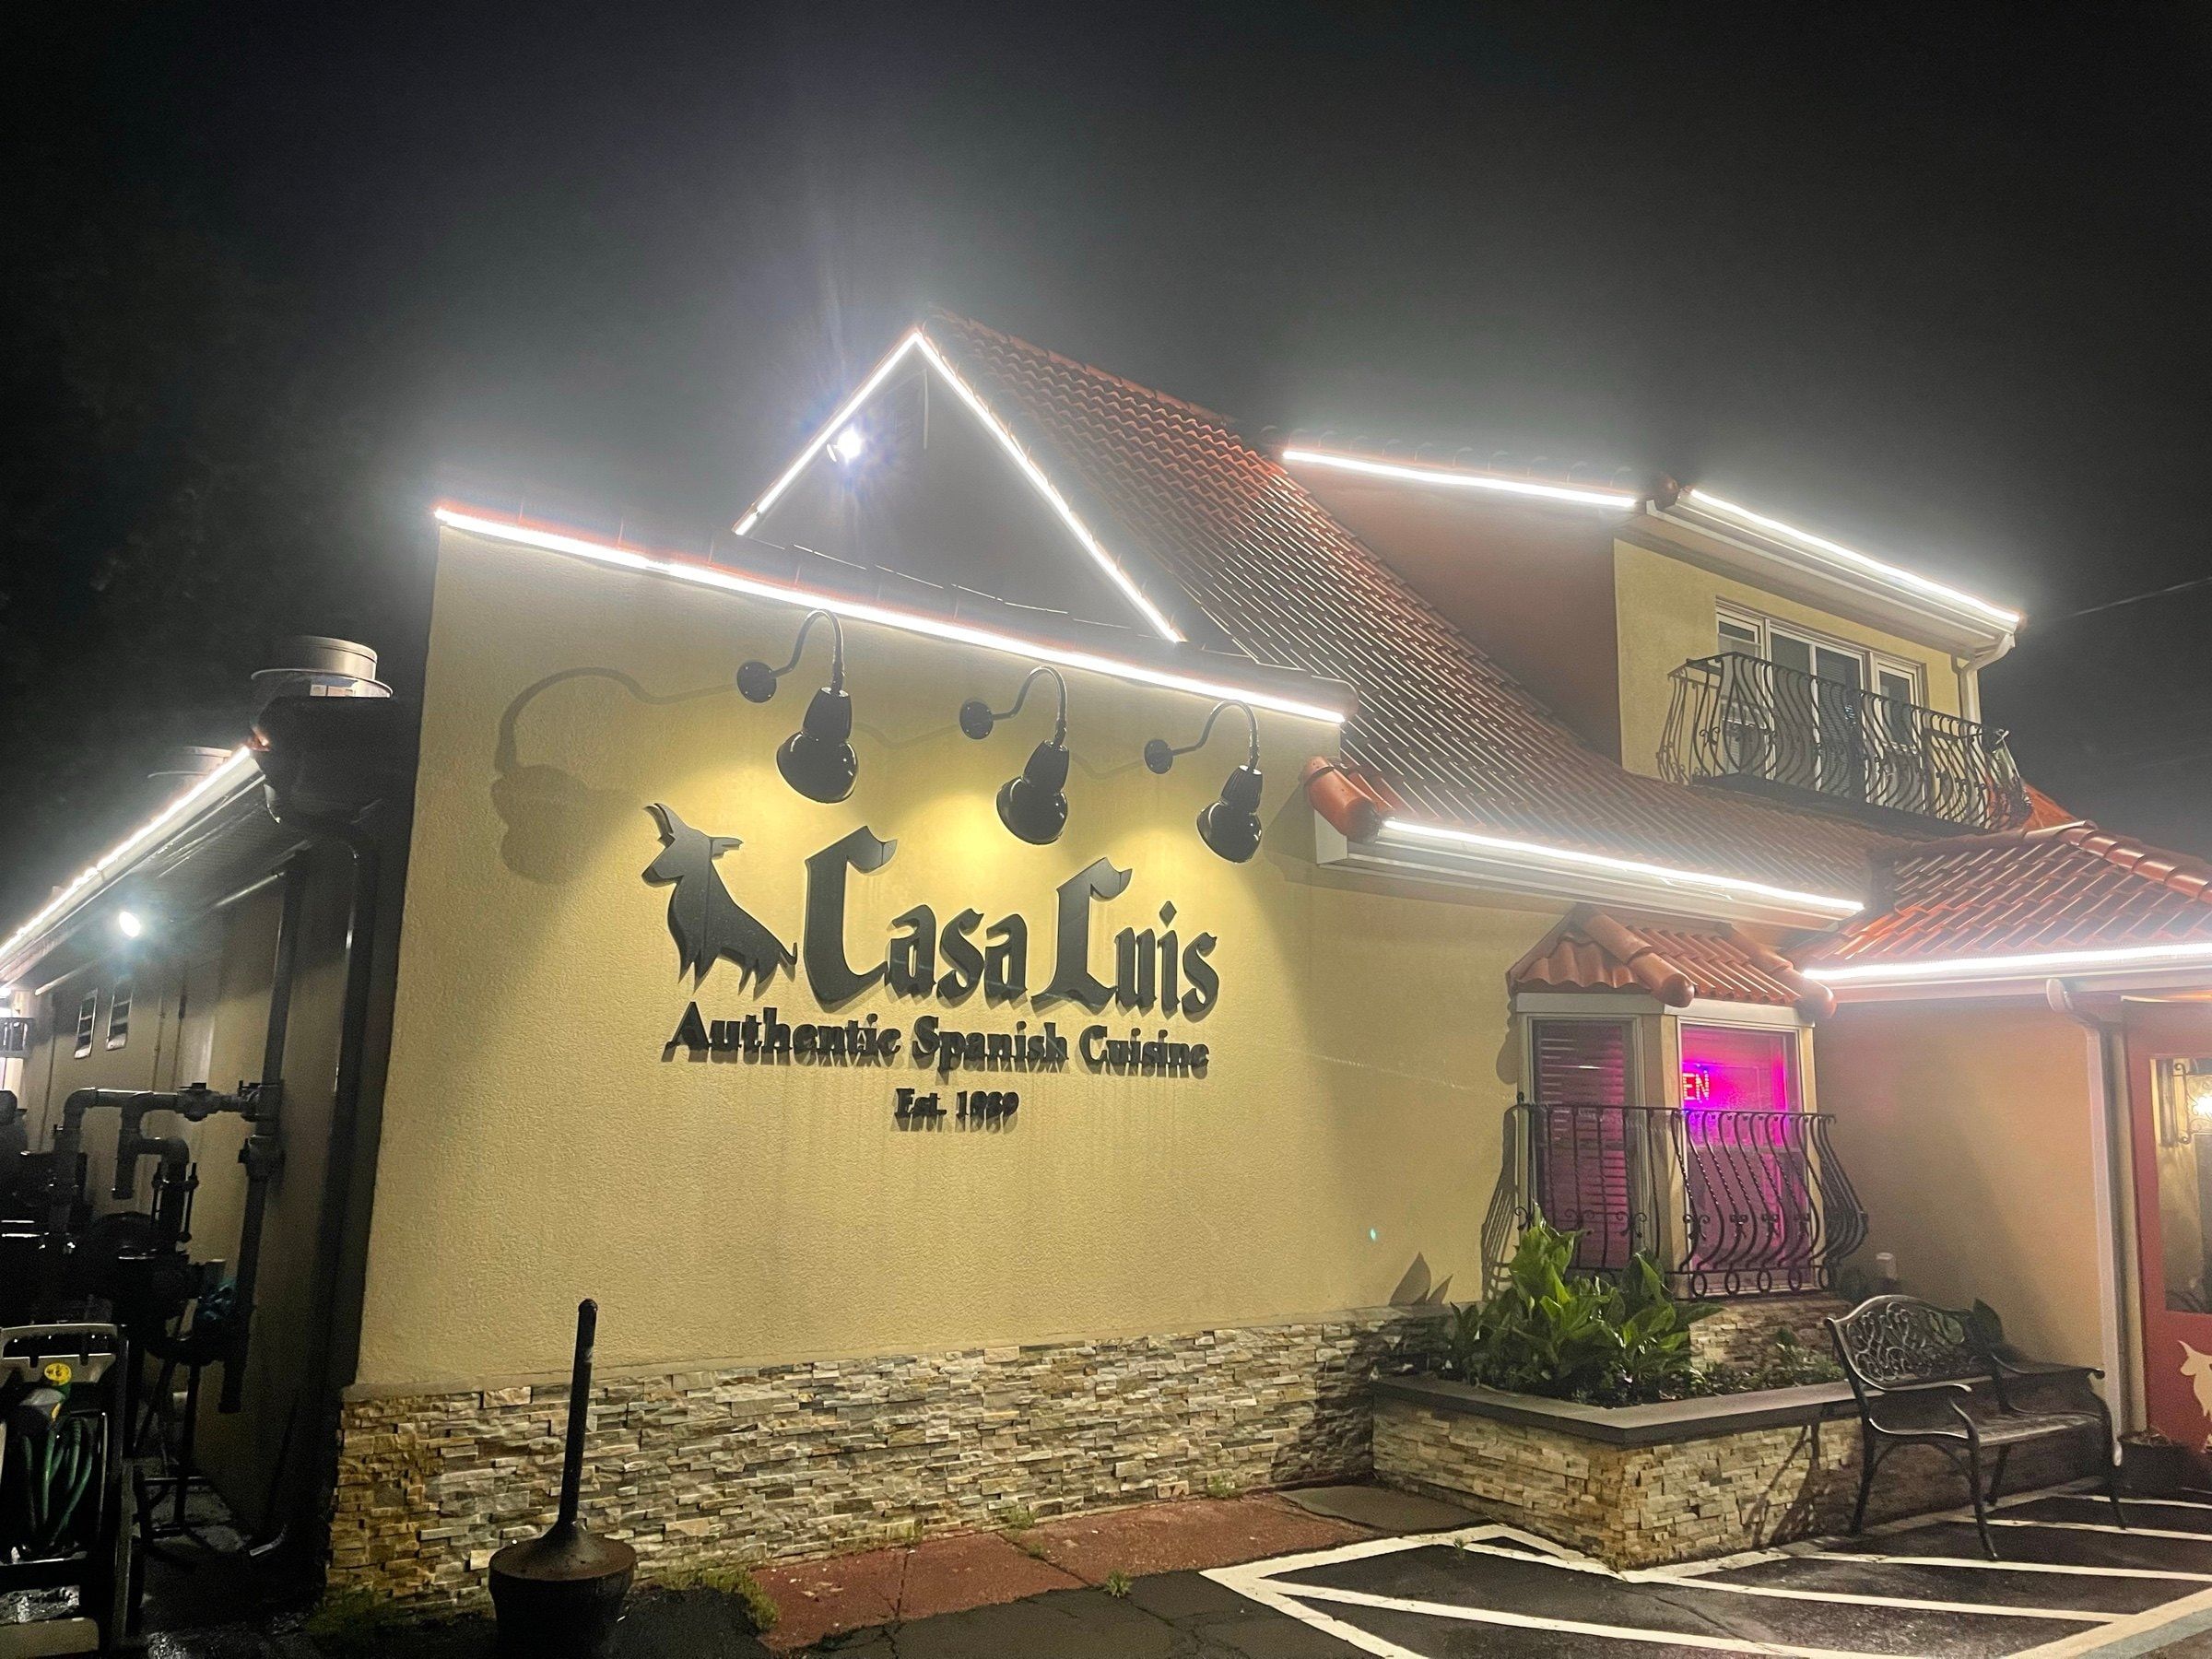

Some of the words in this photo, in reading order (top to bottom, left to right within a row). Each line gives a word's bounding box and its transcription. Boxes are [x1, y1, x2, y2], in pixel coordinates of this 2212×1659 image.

[804, 826, 1029, 1007] Casa
[1031, 857, 1220, 1018] Luis
[664, 1001, 901, 1056] Authentic
[912, 1015, 1069, 1074] Spanish
[1078, 1024, 1209, 1069] Cuisine
[894, 1088, 947, 1118] Est.
[1682, 1070, 1710, 1102] EN
